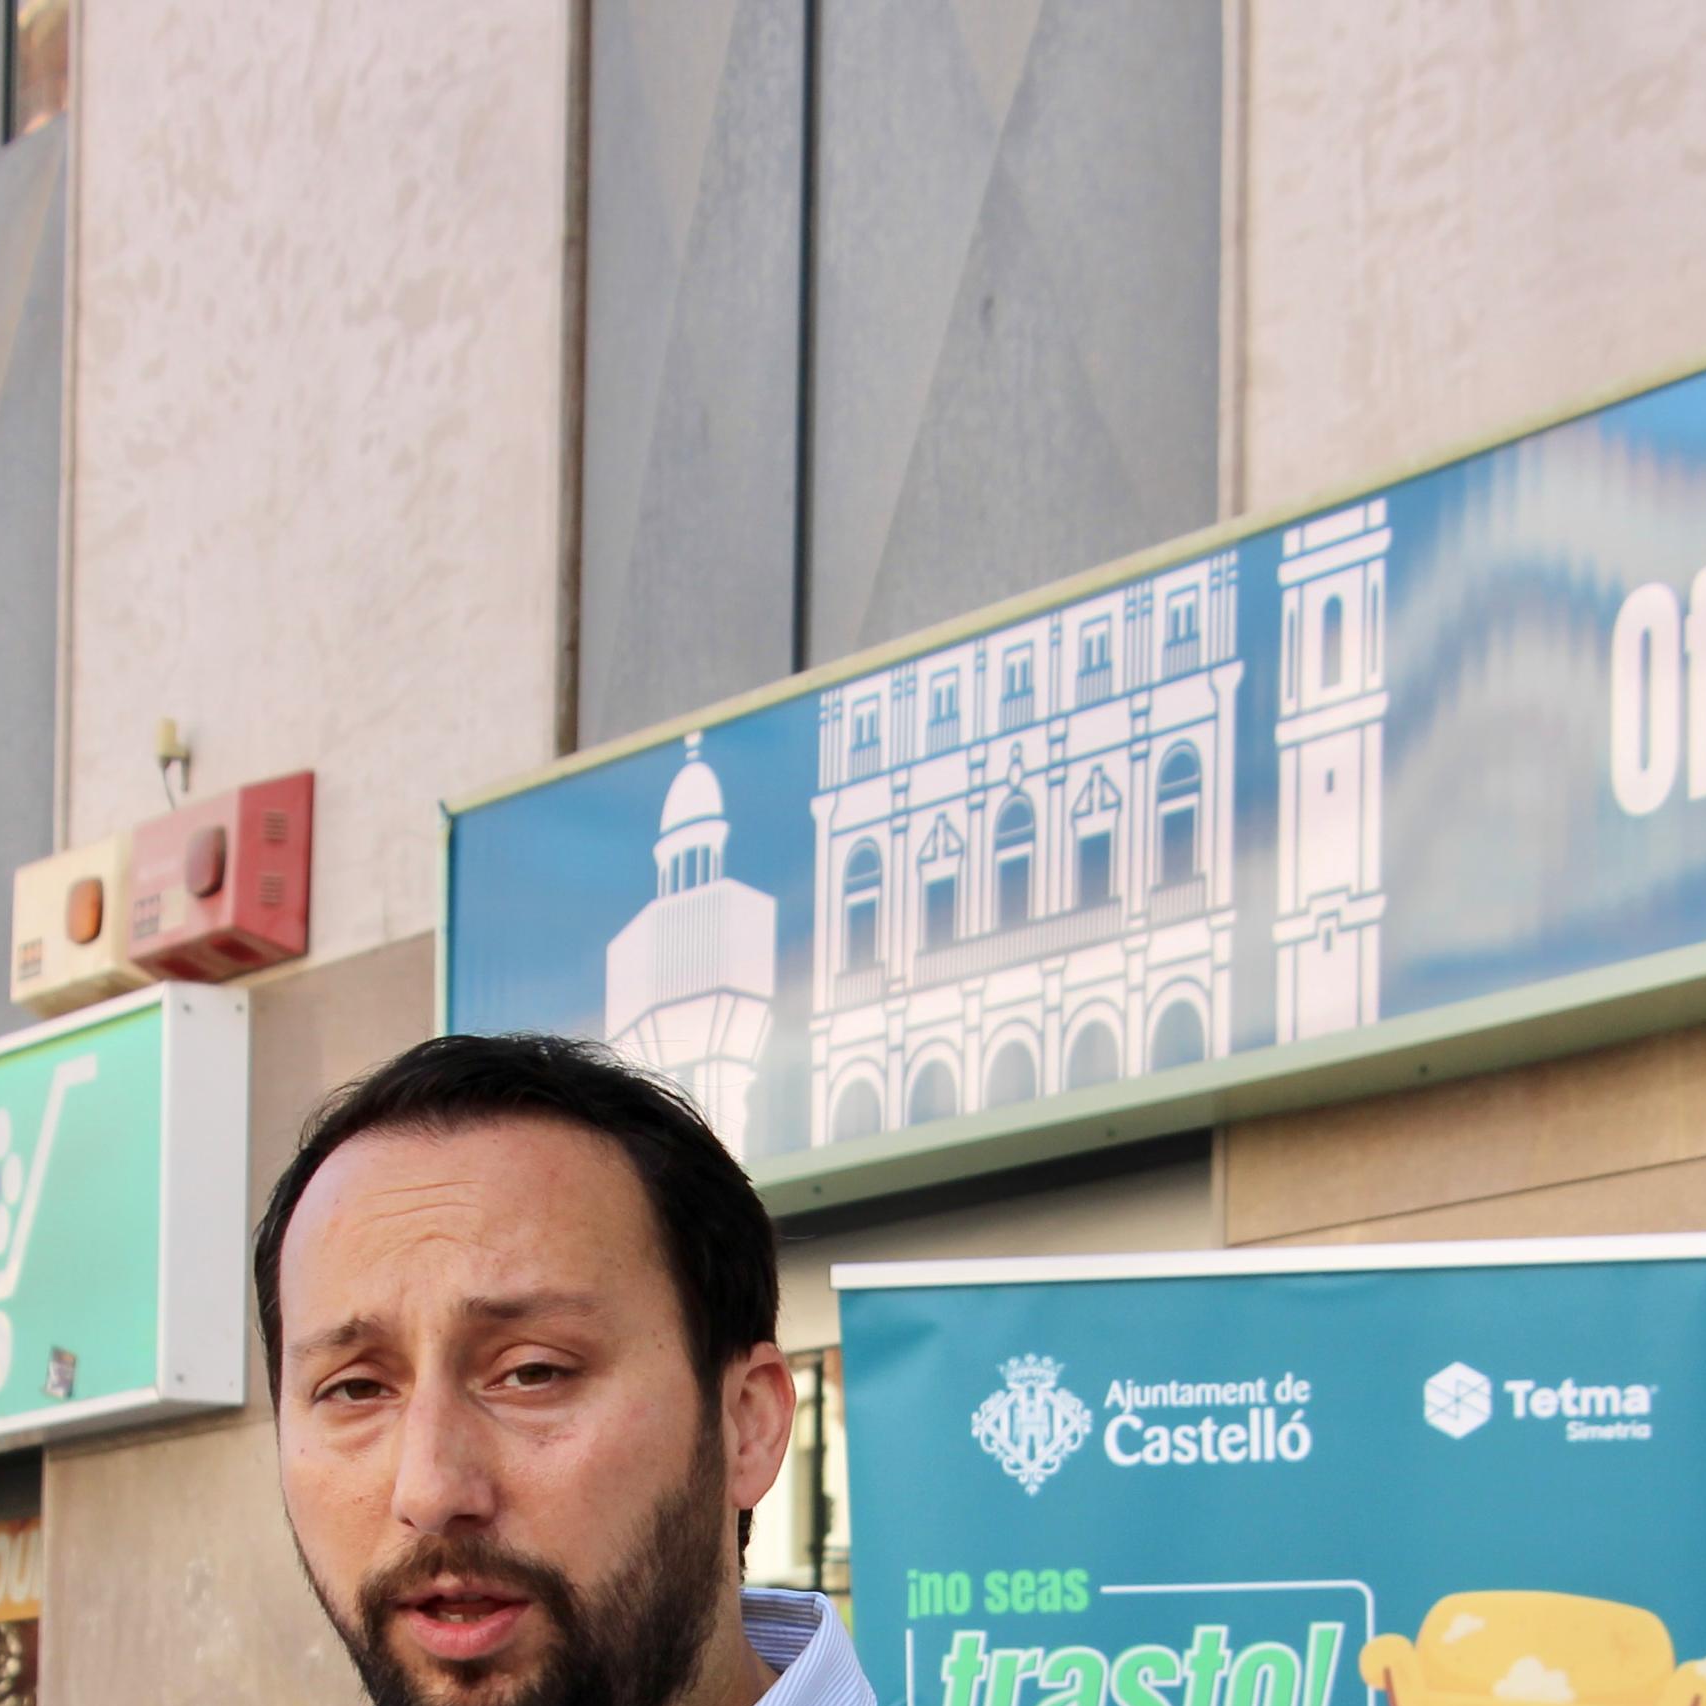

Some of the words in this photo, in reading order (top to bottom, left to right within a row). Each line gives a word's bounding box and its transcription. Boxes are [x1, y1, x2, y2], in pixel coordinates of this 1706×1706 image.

[1104, 1378, 1267, 1414] Ajuntament
[1274, 1371, 1311, 1404] de
[1503, 1377, 1652, 1419] Tetma
[1103, 1406, 1312, 1467] Castelló
[907, 1568, 973, 1619] ¡no
[984, 1567, 1091, 1615] seas
